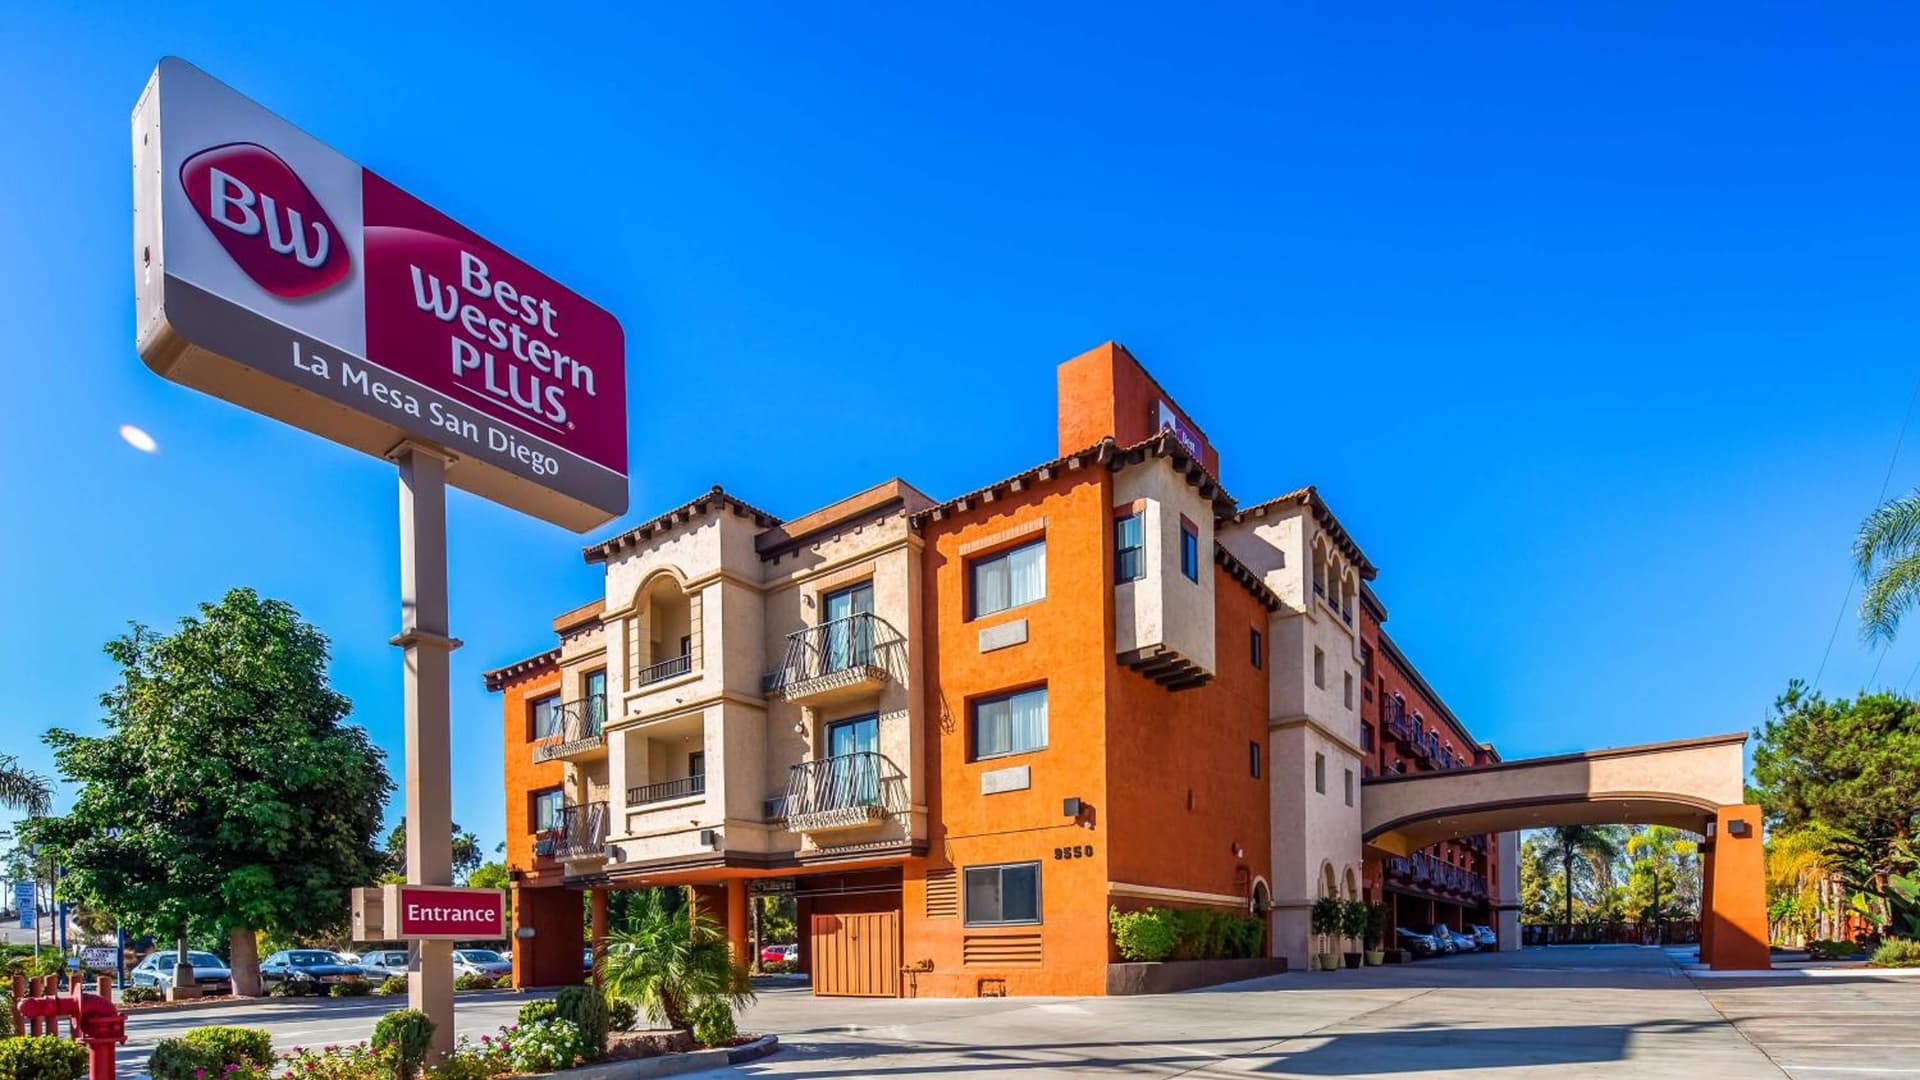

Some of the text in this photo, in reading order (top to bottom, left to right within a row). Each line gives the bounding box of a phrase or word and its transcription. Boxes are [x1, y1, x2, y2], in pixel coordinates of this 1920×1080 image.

[210, 167, 329, 268] BW
[410, 264, 596, 396] Western
[460, 250, 559, 337] Best
[293, 341, 559, 476] La Mesa San Diego
[452, 335, 567, 423] PLUS
[1054, 845, 1094, 860] 9550
[408, 904, 495, 922] Entrance
